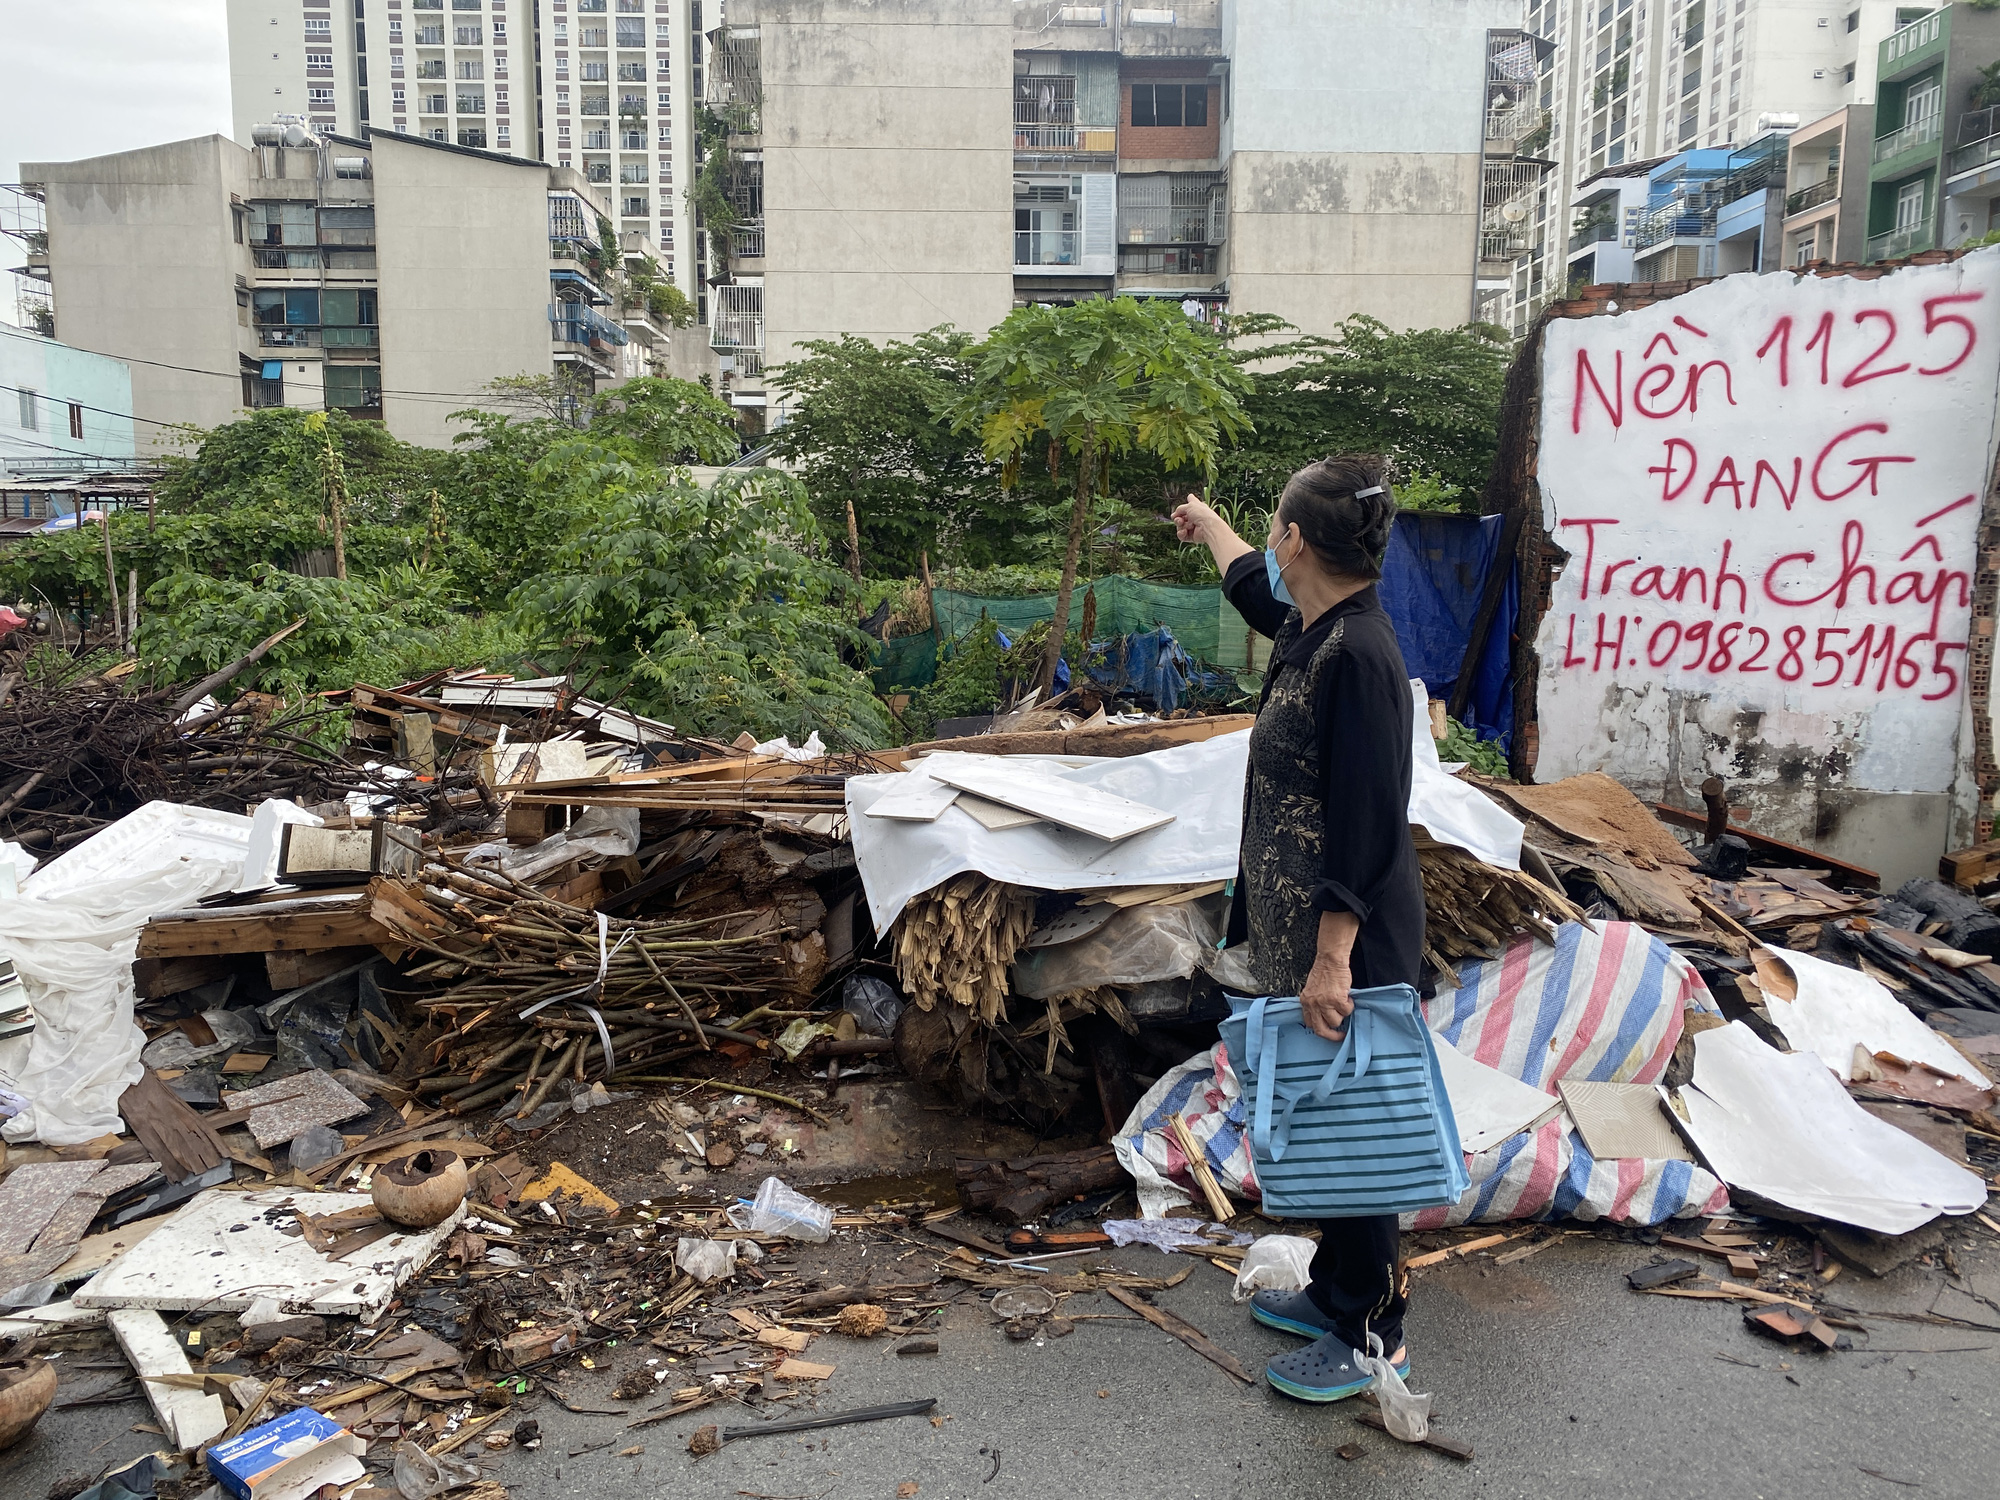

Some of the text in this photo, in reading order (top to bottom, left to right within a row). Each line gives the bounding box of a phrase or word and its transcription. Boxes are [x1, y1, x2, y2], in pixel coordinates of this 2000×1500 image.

[1572, 291, 1987, 434] Nền 1125
[1648, 422, 1916, 511] ĐANG
[1560, 518, 1747, 614] Tranh
